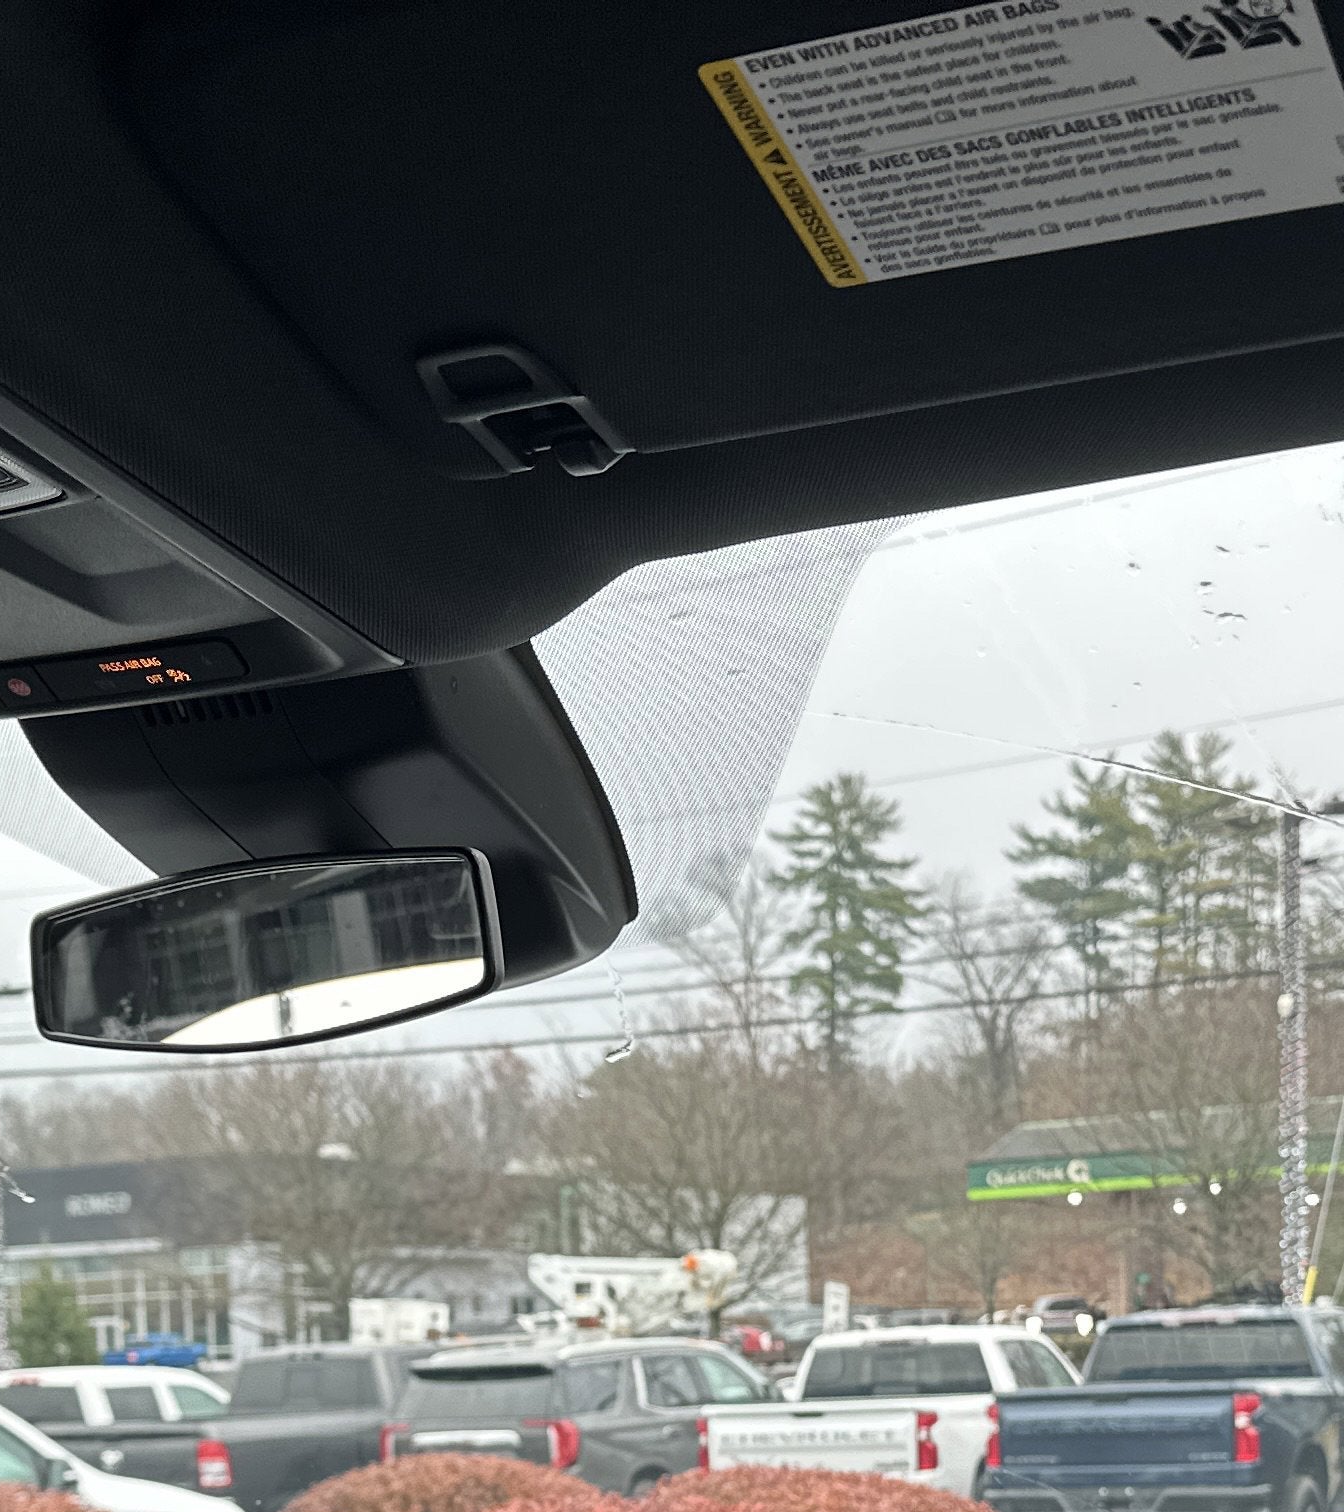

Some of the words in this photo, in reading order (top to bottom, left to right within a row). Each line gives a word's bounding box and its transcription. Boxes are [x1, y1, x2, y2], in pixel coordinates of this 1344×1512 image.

[744, 50, 795, 73] EVEN
[795, 38, 848, 61] WITH
[852, 15, 957, 50] ADVANCED
[962, 7, 997, 26] AIR
[1000, 0, 1058, 16] BAGS
[714, 70, 772, 147] WARNING
[811, 162, 865, 183] MÊME
[868, 151, 913, 172] AVEC
[914, 144, 952, 163] DES
[953, 135, 1003, 155] SACS
[1004, 112, 1122, 146] GONFLABLES
[1124, 87, 1256, 123] INTELLIGENTS
[773, 170, 856, 280] AVERTISSEMENT
[98, 662, 124, 673] PASS
